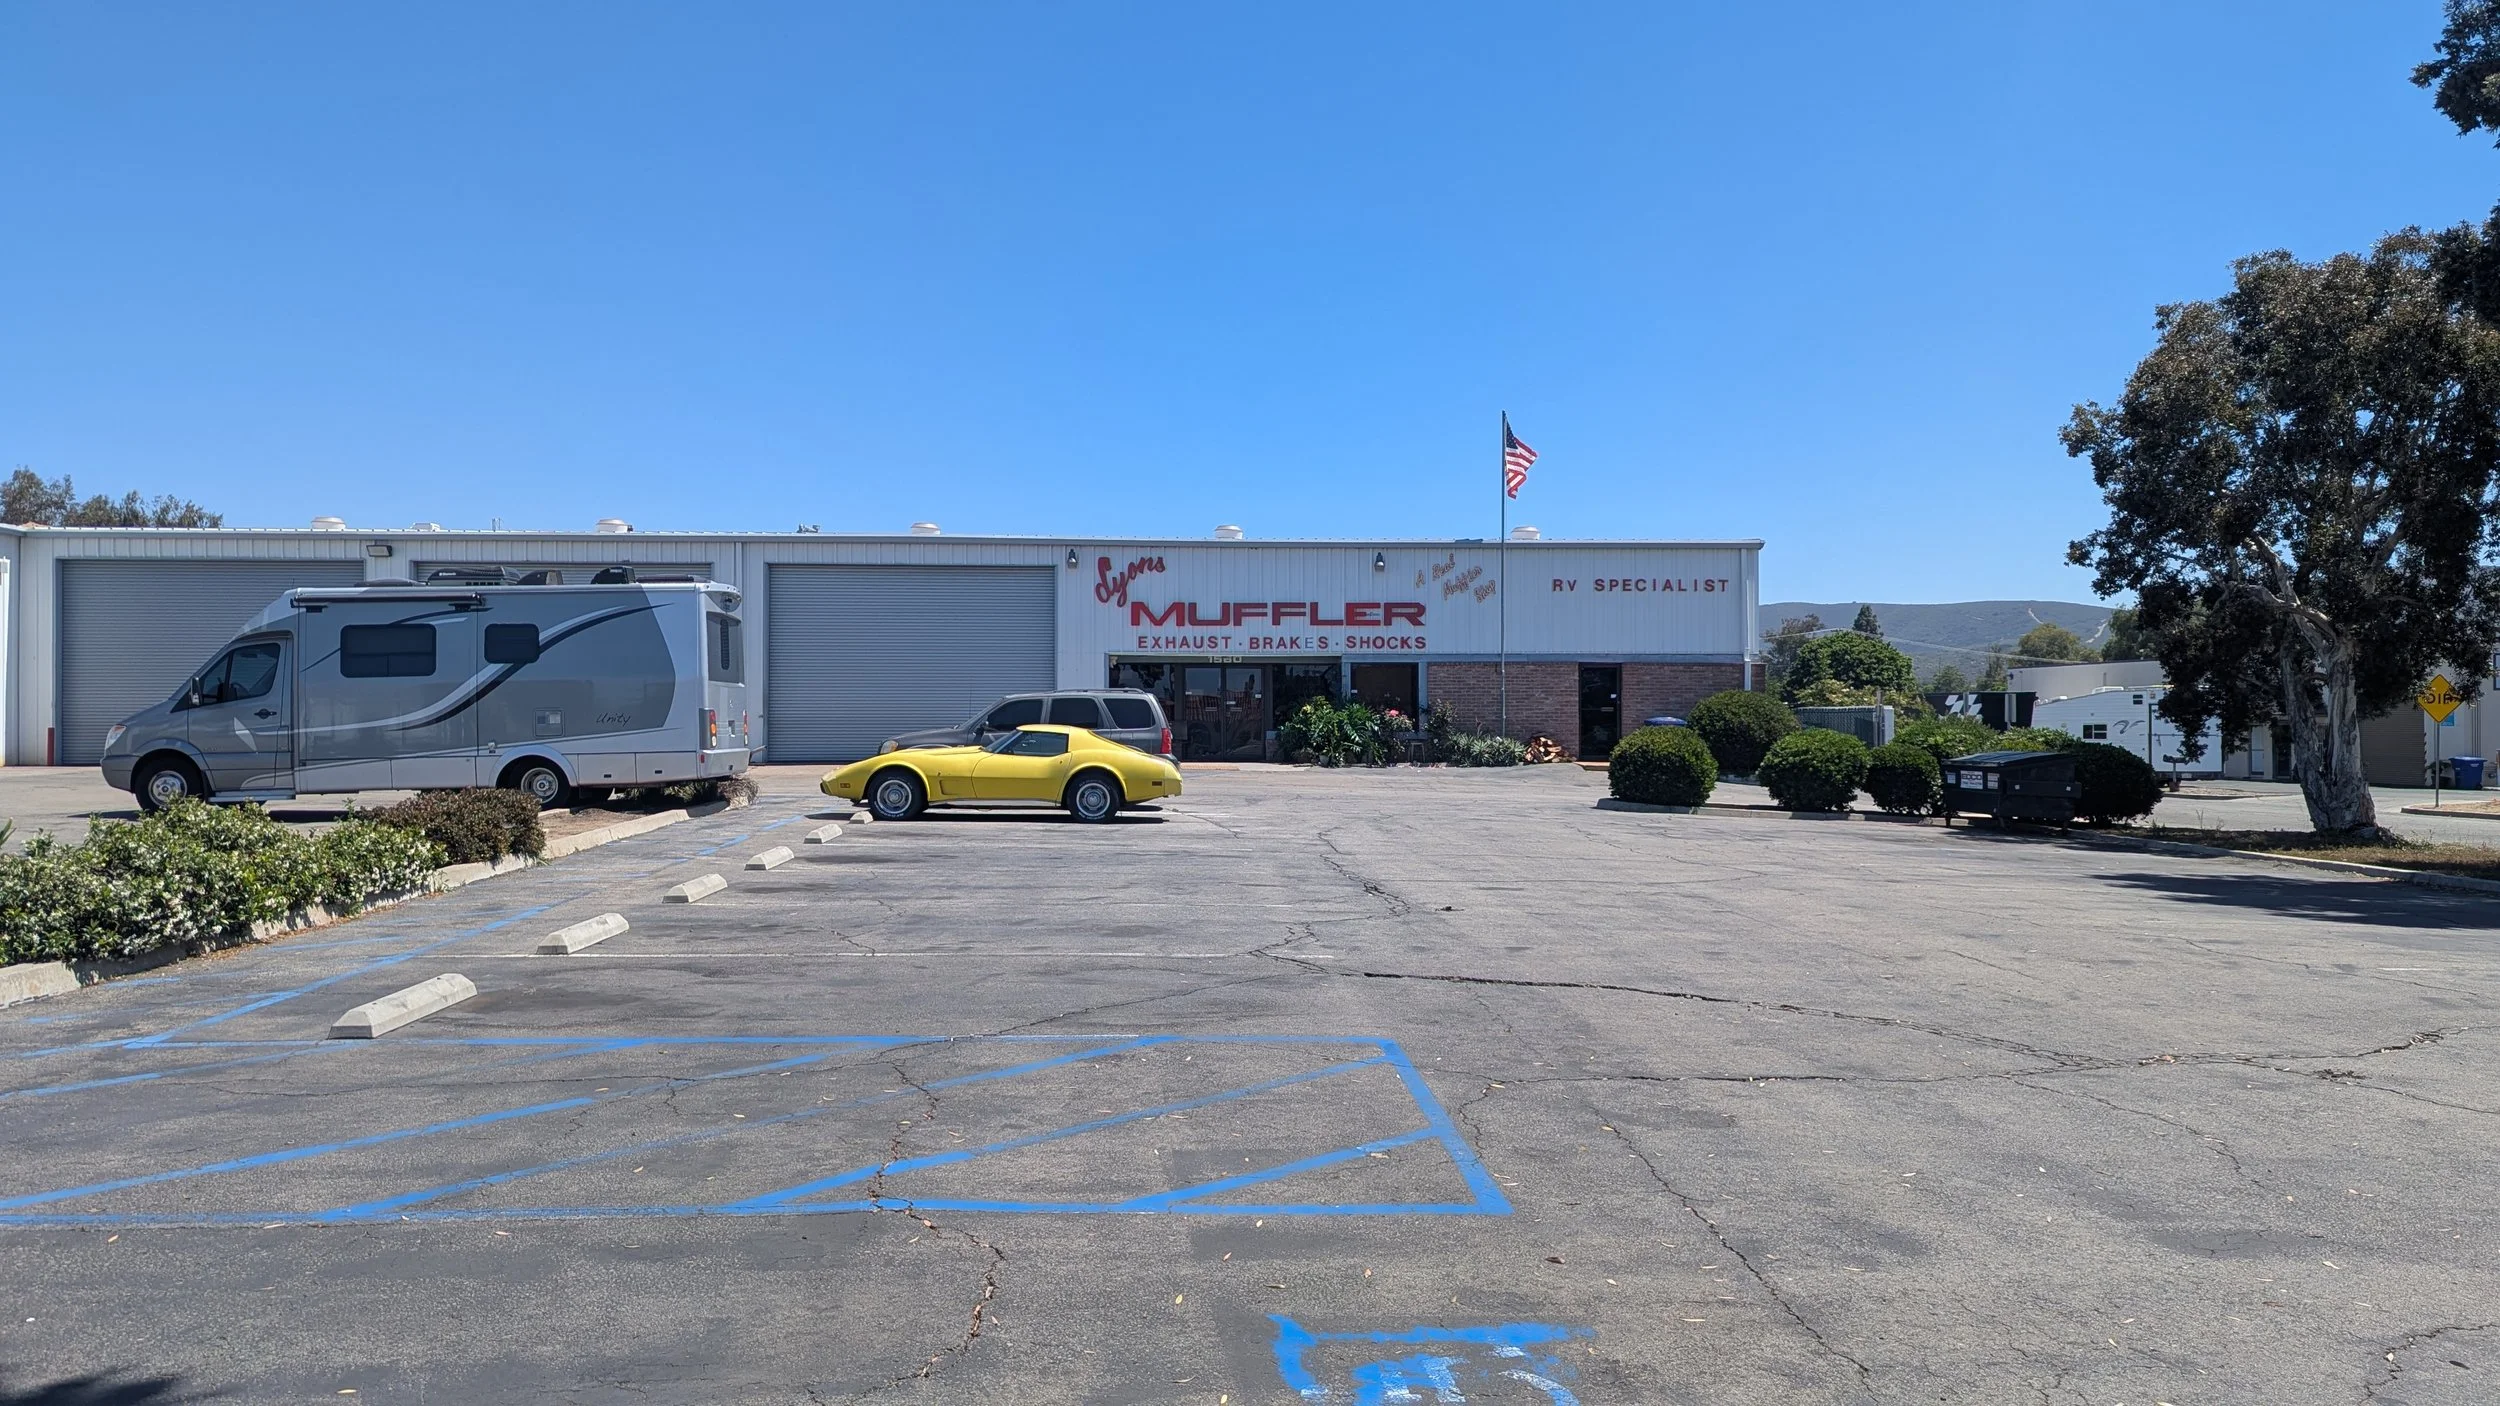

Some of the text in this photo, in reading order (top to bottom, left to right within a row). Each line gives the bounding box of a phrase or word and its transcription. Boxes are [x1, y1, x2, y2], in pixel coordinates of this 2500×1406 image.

[1416, 553, 1455, 588] A Real
[1095, 556, 1165, 608] Lyons
[1552, 578, 1729, 592] RV SPECIALIST
[1130, 601, 1426, 627] MUFFLER
[1137, 635, 1427, 650] EXHAUST BRAKES SHOCKS
[1207, 656, 1243, 664] 1580
[596, 712, 631, 727] Unity
